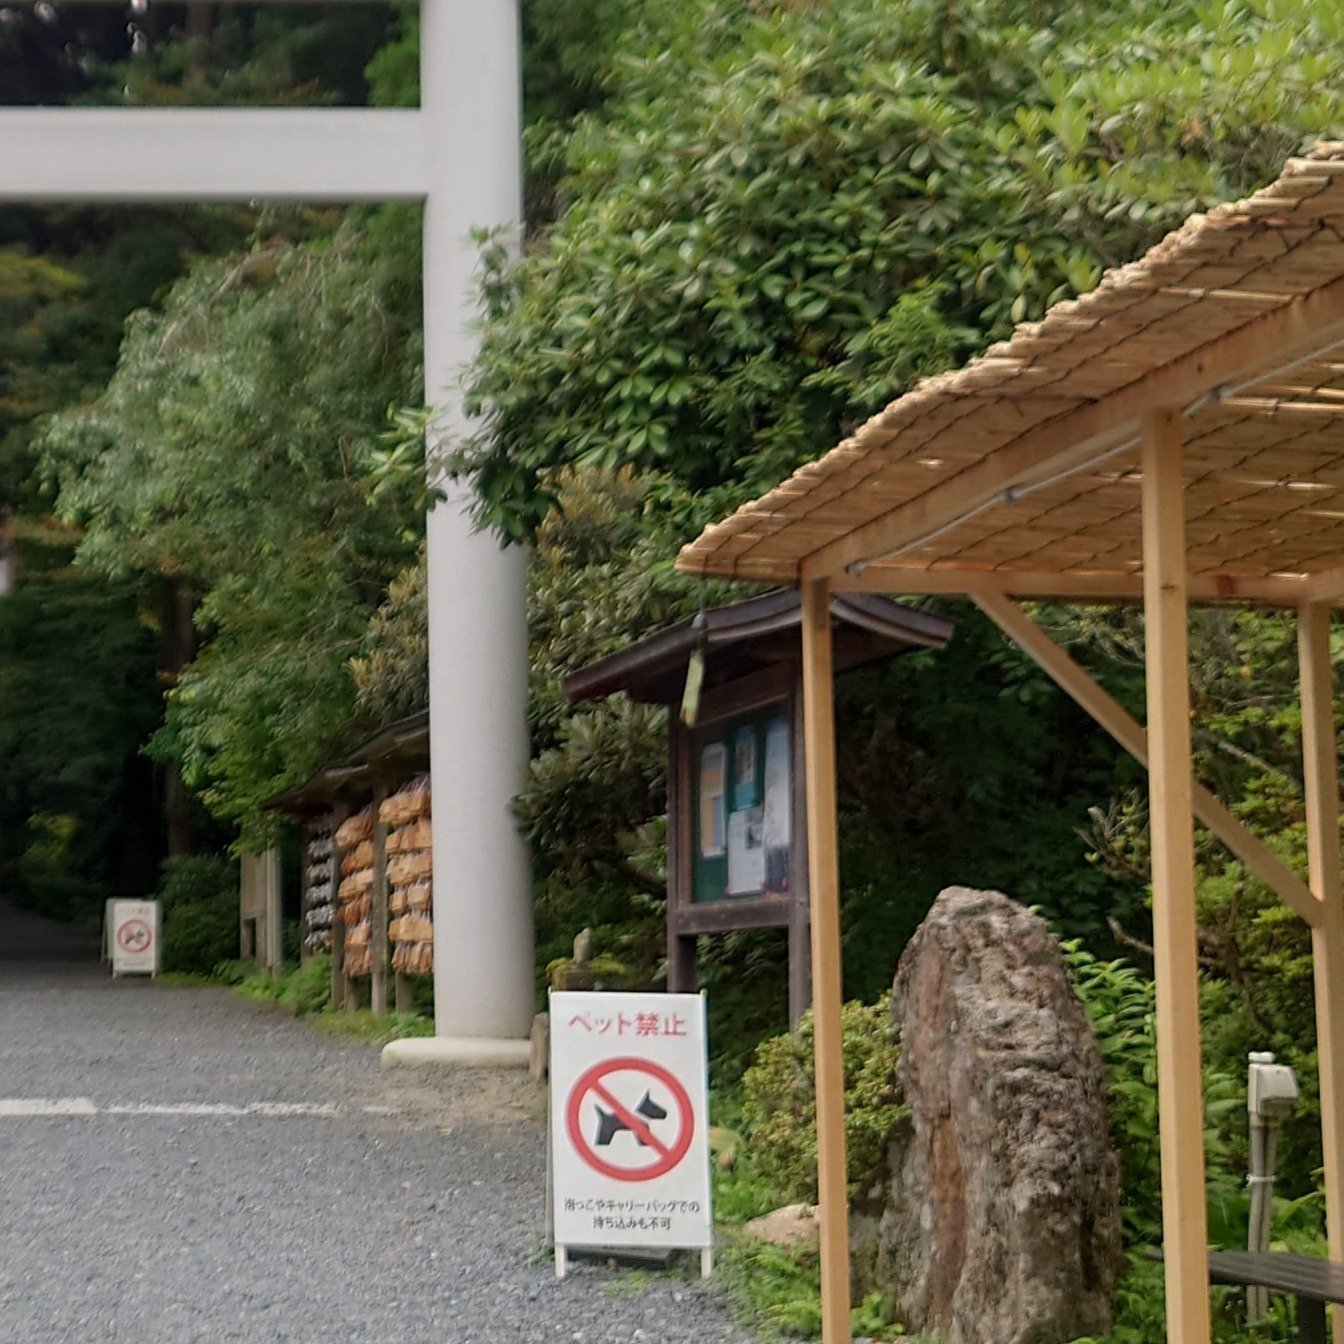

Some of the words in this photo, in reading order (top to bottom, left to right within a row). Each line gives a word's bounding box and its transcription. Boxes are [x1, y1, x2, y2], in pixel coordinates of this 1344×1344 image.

[568, 1010, 687, 1036] ペット禁止
[593, 1216, 671, 1230] 持ち込みも不可
